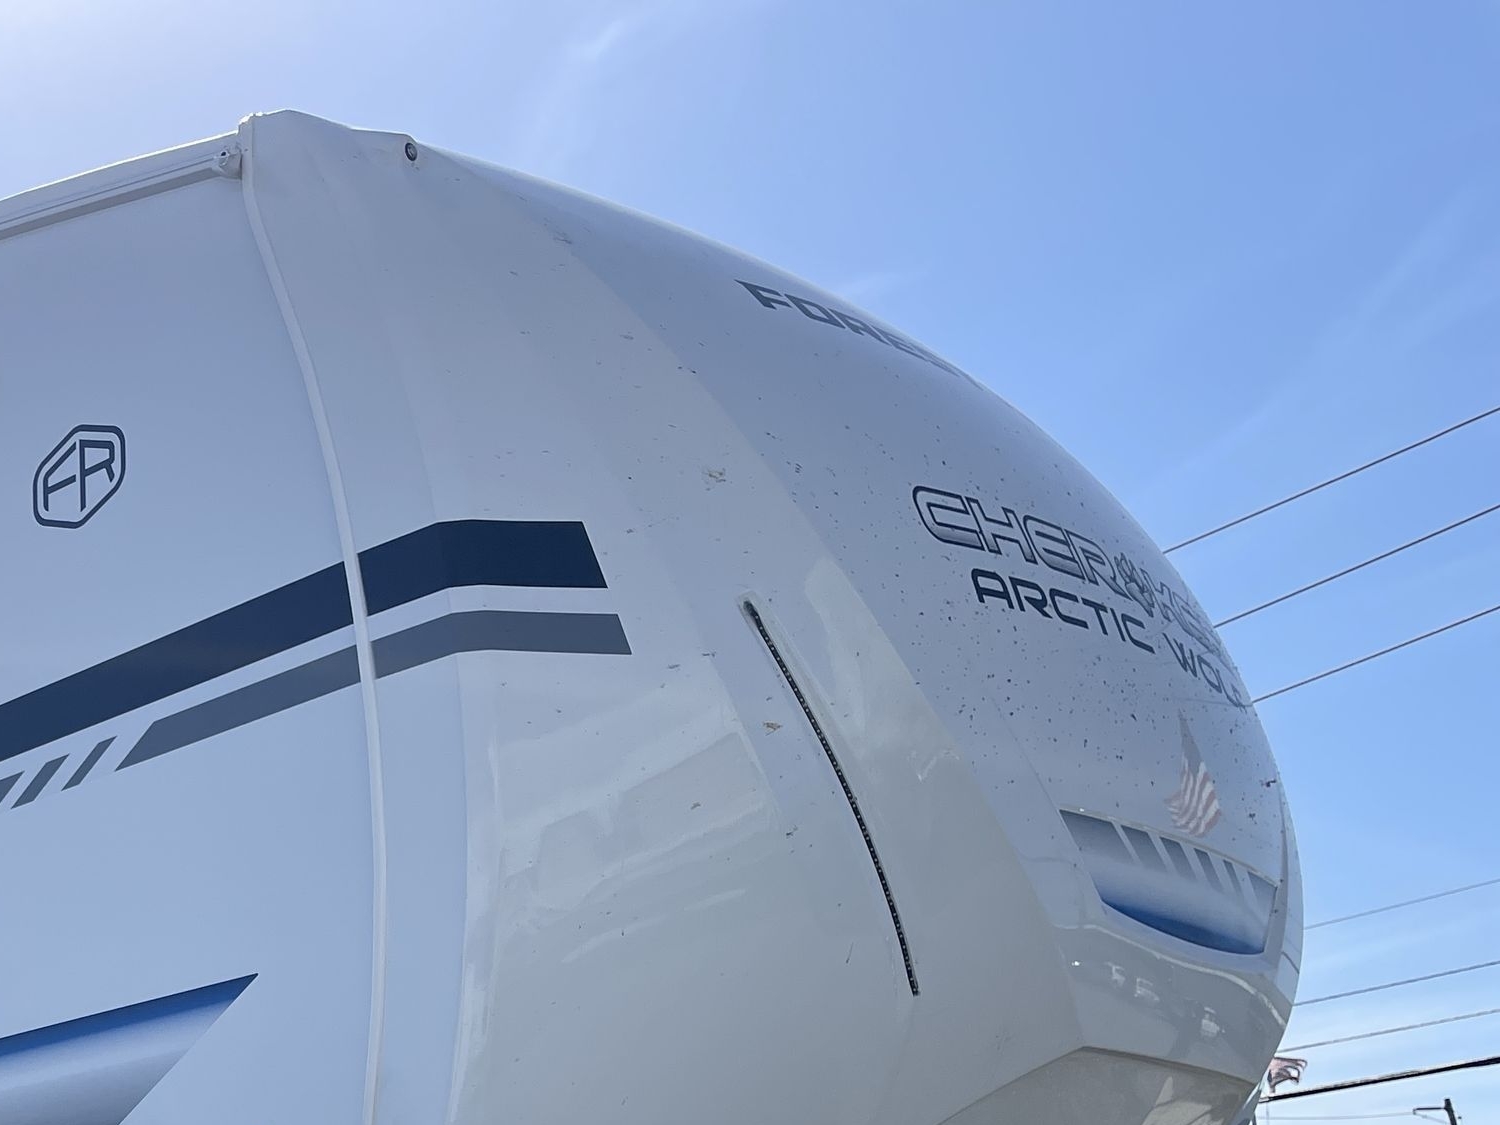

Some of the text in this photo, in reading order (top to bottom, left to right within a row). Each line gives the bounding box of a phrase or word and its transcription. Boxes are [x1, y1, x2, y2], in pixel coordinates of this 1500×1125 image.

[734, 278, 984, 392] FORE
[911, 484, 1238, 678] CHEROKE
[970, 568, 1156, 655] ARCTIC
